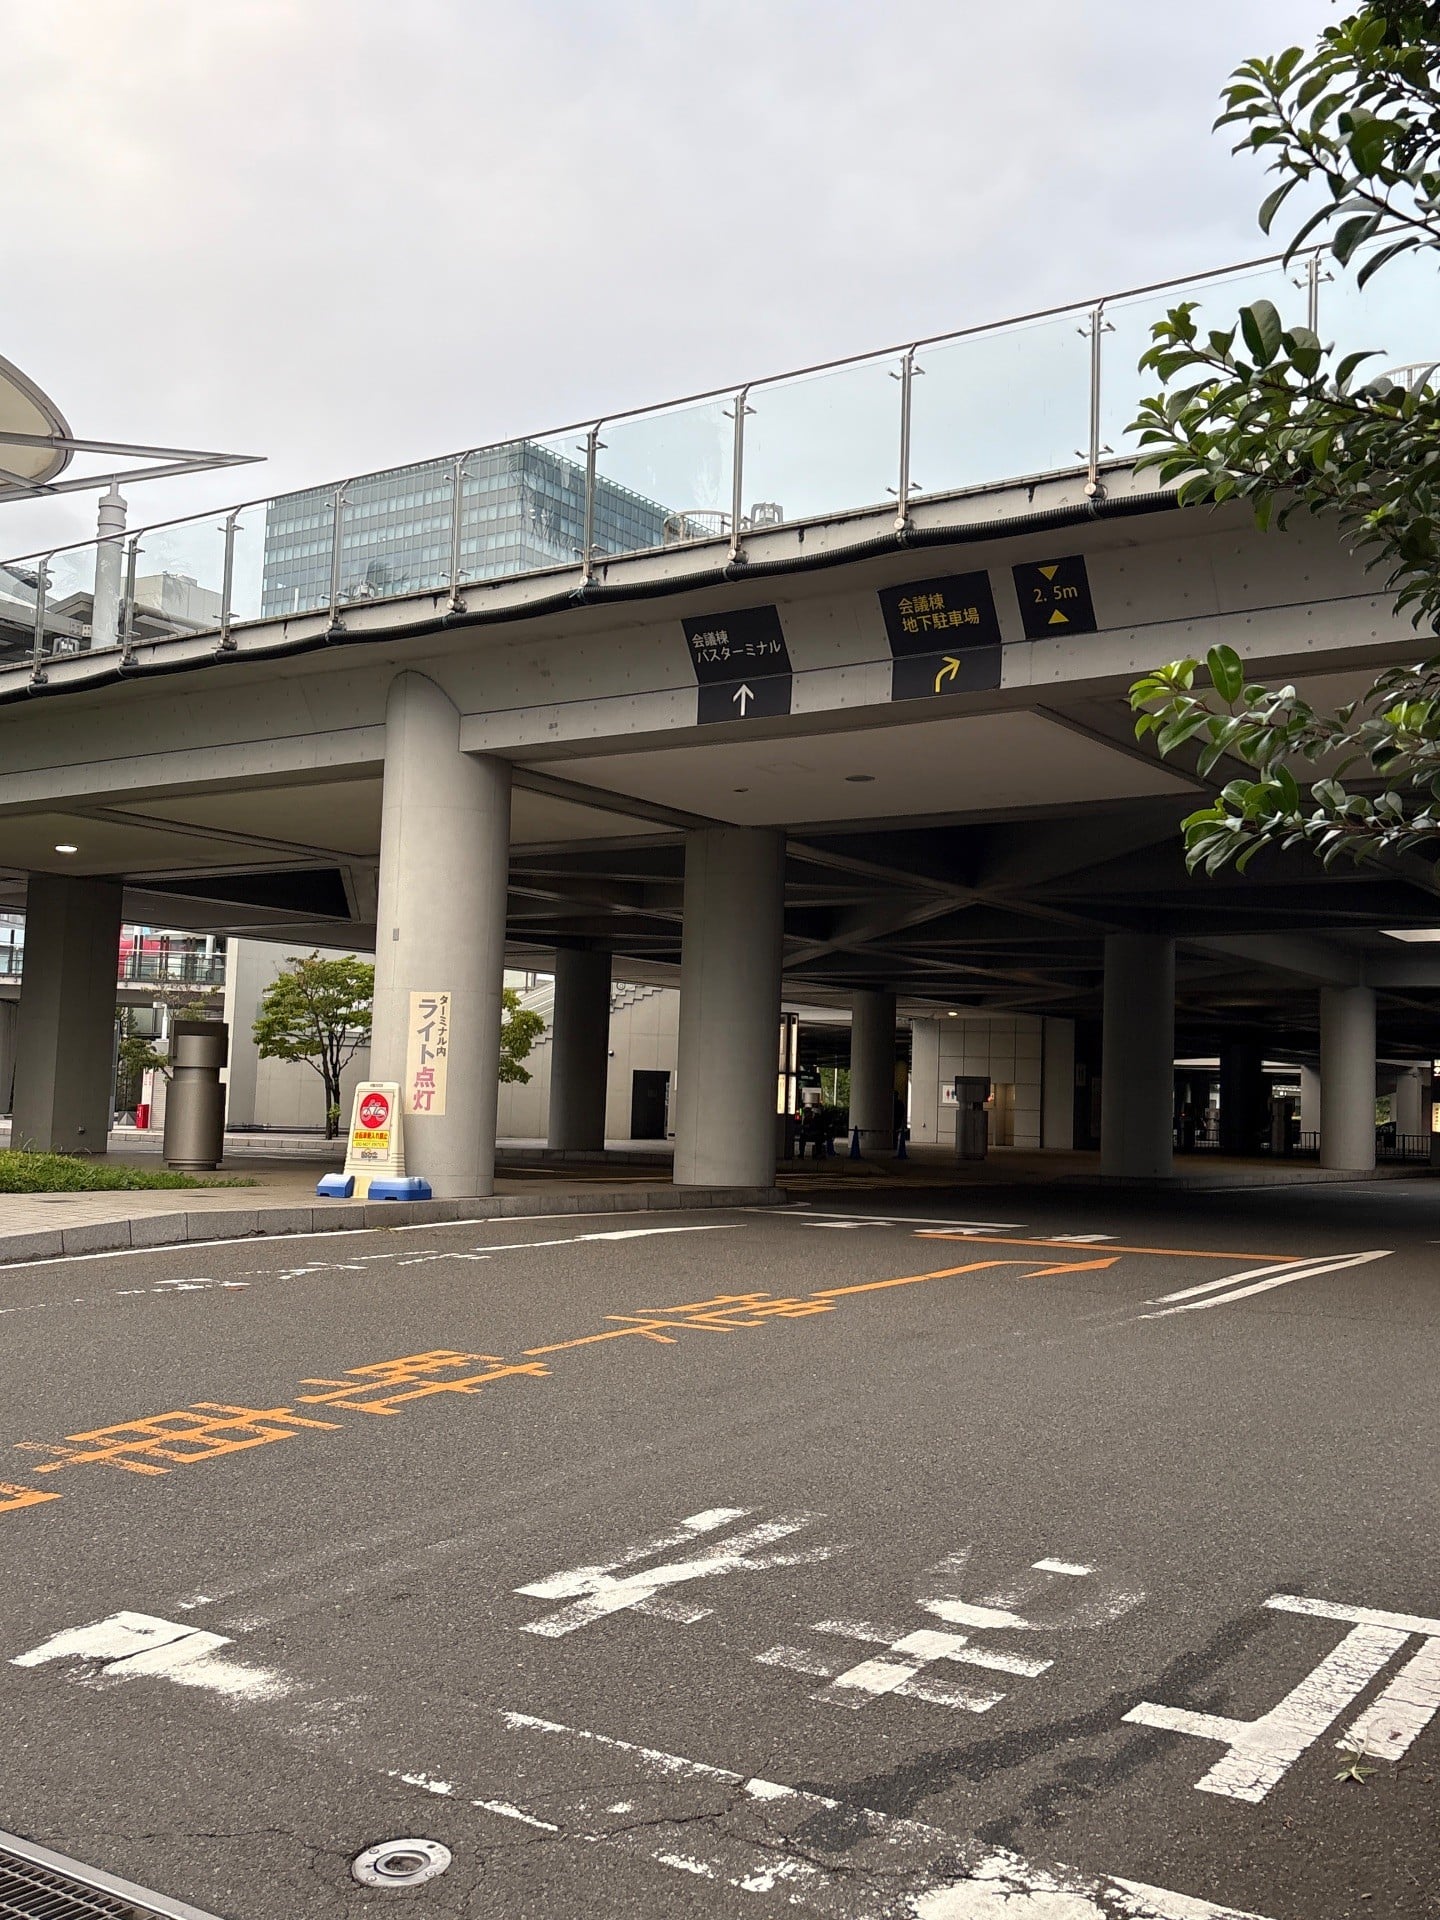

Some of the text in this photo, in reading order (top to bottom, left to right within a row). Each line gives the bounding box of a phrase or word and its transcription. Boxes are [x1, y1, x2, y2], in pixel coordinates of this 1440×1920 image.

[898, 592, 946, 615] 会議棟
[901, 606, 981, 634] 地下駐車場
[691, 629, 729, 649] 会議棟
[696, 638, 782, 664] バスターミナル
[436, 995, 449, 1057] ターミナル内
[412, 998, 438, 1112] ライト点灯
[0, 1292, 836, 1512] 地下駐車
